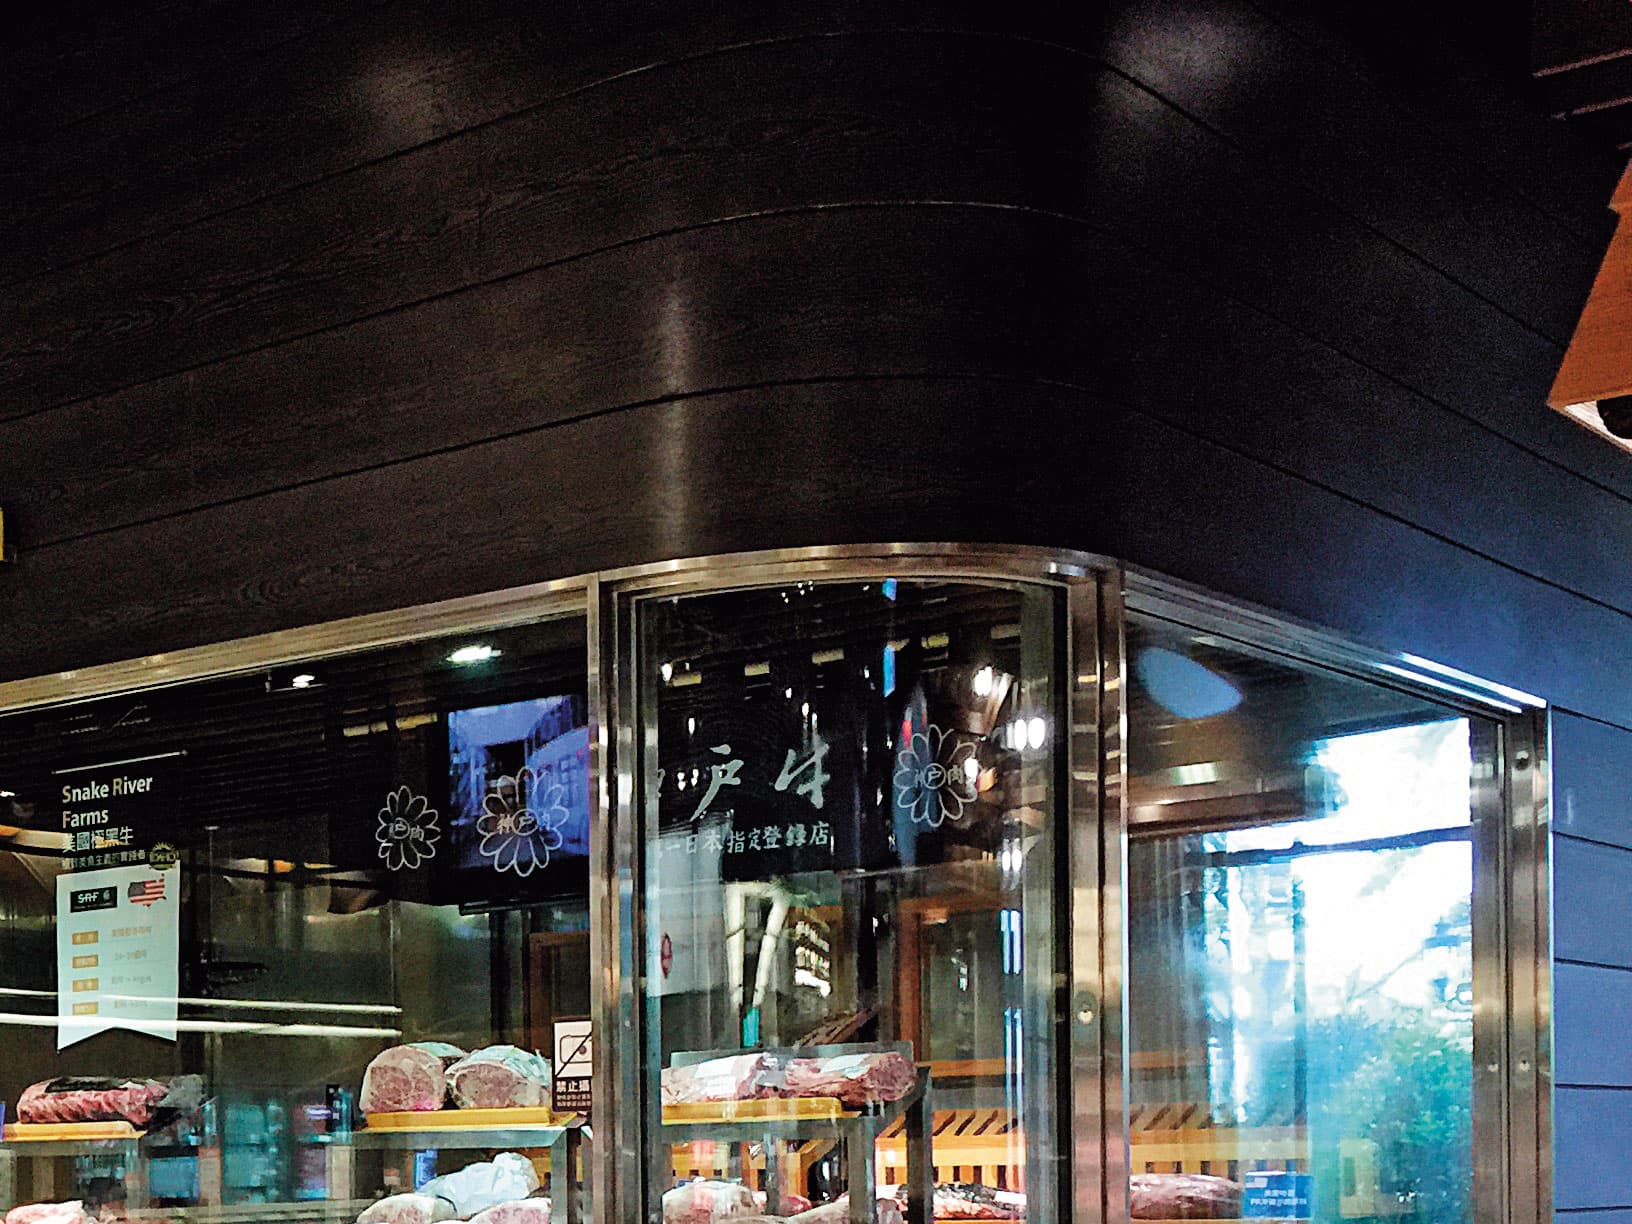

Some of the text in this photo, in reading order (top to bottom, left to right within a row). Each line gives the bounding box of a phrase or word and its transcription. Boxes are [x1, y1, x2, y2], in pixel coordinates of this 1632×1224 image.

[62, 776, 154, 803] Snake River
[62, 809, 109, 829] Farms
